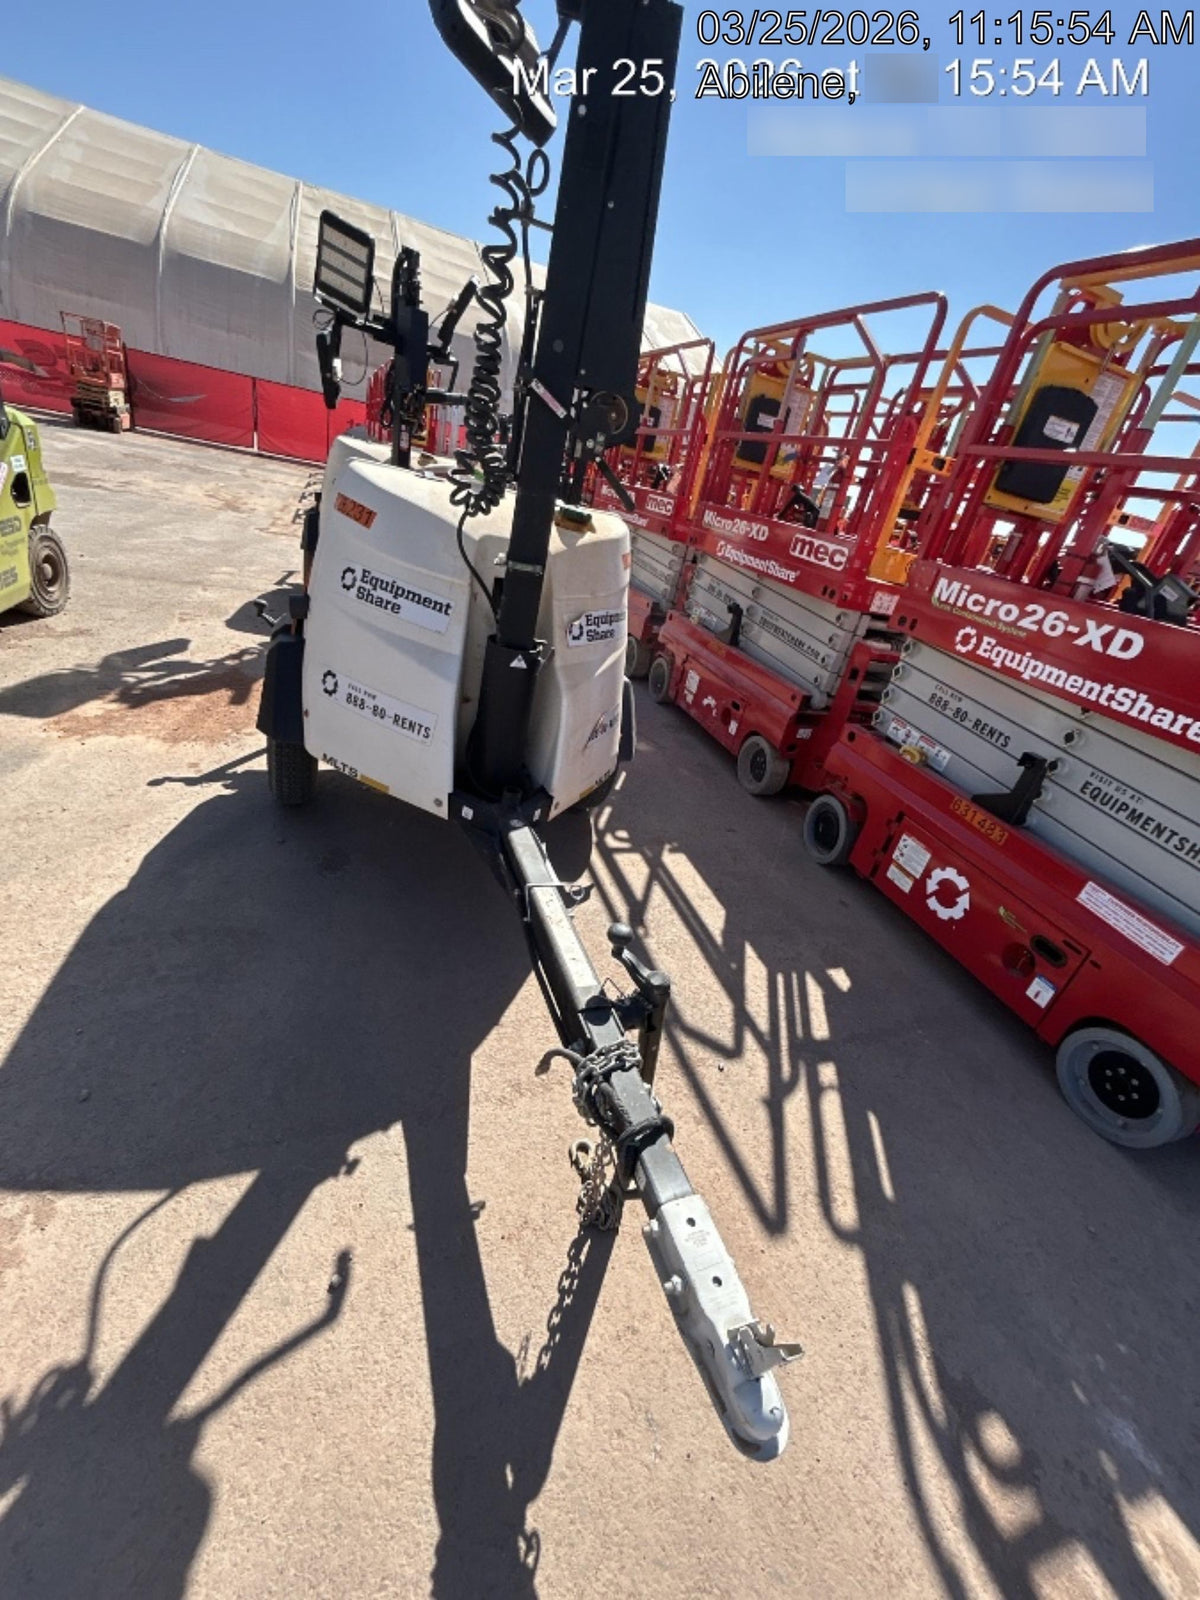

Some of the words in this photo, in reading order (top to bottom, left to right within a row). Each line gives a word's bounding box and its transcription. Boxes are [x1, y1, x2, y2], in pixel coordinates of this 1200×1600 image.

[703, 509, 769, 542] Micro26-XD
[724, 543, 796, 583] EquipmentShare
[790, 533, 849, 571] mec
[356, 586, 402, 614] Share
[360, 568, 452, 616] Equipment
[933, 577, 1145, 661] Micro26-XD
[976, 635, 1200, 745] EquipmentShare
[345, 692, 431, 739] 888-80-RENTS
[928, 692, 1011, 749] 888-80-RENTS
[1079, 780, 1200, 866] EQUIPMENTSH
